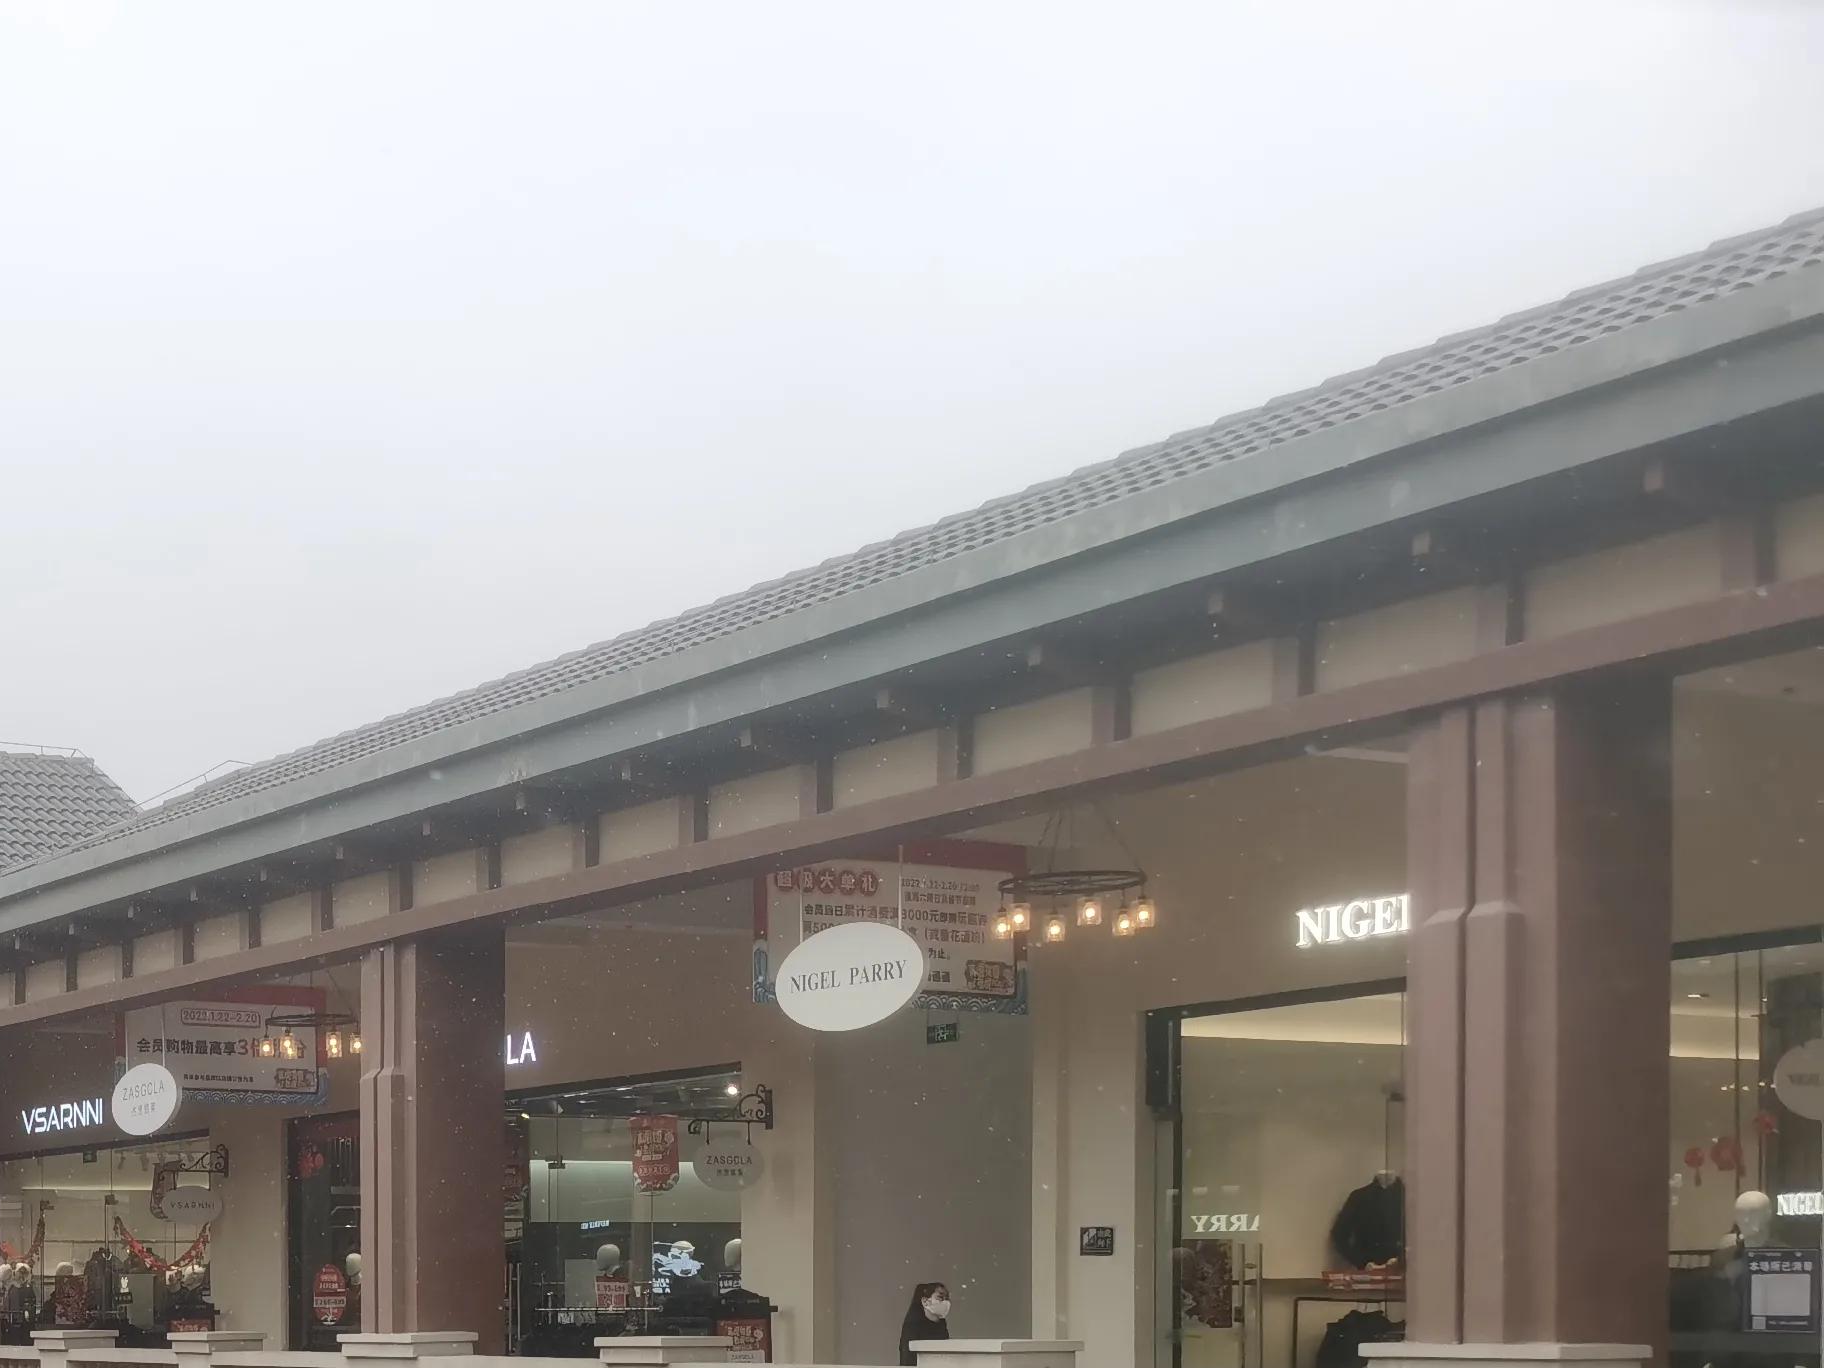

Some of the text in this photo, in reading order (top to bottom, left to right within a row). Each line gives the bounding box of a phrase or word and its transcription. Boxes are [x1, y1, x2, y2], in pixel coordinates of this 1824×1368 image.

[791, 968, 840, 994] NIGEL
[849, 960, 907, 985] PARRY
[182, 1009, 258, 1024] 2022.1.22-2.20
[506, 1031, 537, 1065] LA
[122, 1080, 165, 1101] ZASGOLA
[21, 1098, 103, 1135] VSARNNI
